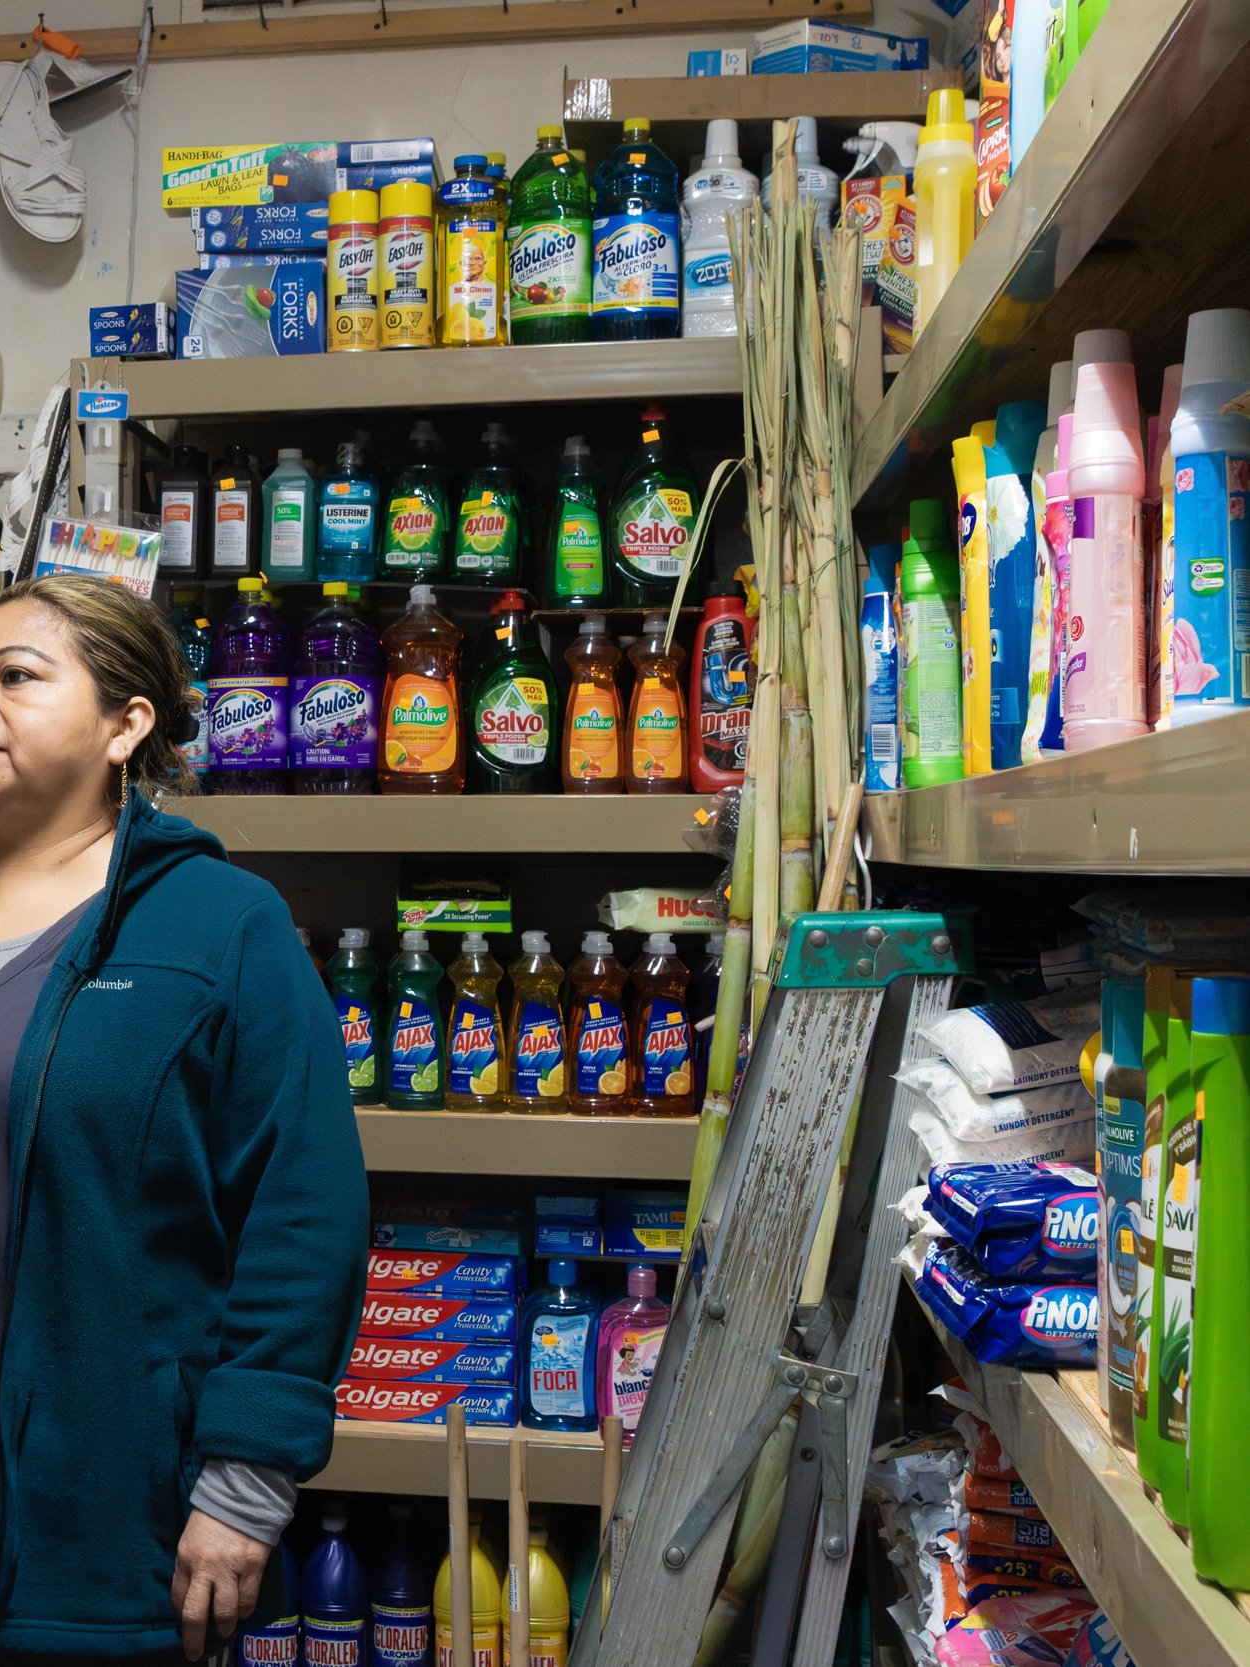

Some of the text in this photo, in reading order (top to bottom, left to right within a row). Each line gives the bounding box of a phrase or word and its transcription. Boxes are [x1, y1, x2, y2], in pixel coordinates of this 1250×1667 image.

[229, 149, 268, 173] Tuff
[200, 167, 265, 191] LAWN & LEAF
[218, 181, 242, 195] BAGS
[451, 183, 470, 194] 2X
[256, 207, 297, 218] FORKS
[261, 229, 302, 240] FORKS
[510, 233, 577, 280] Fabuloso
[599, 233, 668, 274] Fabuloso
[623, 260, 653, 277] CLORO
[282, 281, 298, 340] FORKS
[93, 320, 126, 330] SPOONS
[95, 343, 127, 353] SPOONS
[190, 338, 201, 354] 24
[667, 497, 688, 507] 50%
[325, 508, 370, 518] LISTERINE
[392, 512, 434, 532] AXION
[464, 514, 505, 535] AXION
[624, 521, 688, 545] Salvo
[562, 535, 597, 548] Palmolive
[523, 686, 543, 695] 50%
[210, 697, 273, 735] Fabuloso
[298, 689, 366, 726] Fabuloso
[394, 706, 447, 722] Palmolive
[482, 709, 543, 733] Salvo
[576, 717, 613, 729] Palmolive
[639, 717, 677, 728] Palmolive
[701, 709, 752, 739] Dran
[722, 727, 745, 740] MAX
[394, 1023, 435, 1055] AJAX
[452, 1025, 495, 1056] AJAX
[519, 1026, 561, 1057] AJAX
[581, 1025, 623, 1055] AJAX
[646, 1025, 688, 1056] AJAX
[1013, 1065, 1080, 1086] LAUNDRY DETERG
[994, 1107, 1076, 1133] LAUNDRY DETERGENT
[453, 1274, 490, 1283] Protection
[455, 1265, 493, 1279] Cavity
[453, 1321, 492, 1331] Protection
[456, 1312, 494, 1326] Cavity
[350, 1344, 493, 1368] olgate Cavity
[453, 1363, 491, 1373] Protection
[533, 1370, 578, 1392] FOCA
[335, 1384, 494, 1411] Colgate Cavity
[243, 1635, 297, 1661] CLORALEN
[375, 1625, 427, 1653] CLORALEN
[305, 1635, 358, 1665] CLORALEN
[382, 1649, 422, 1660] AROMAS
